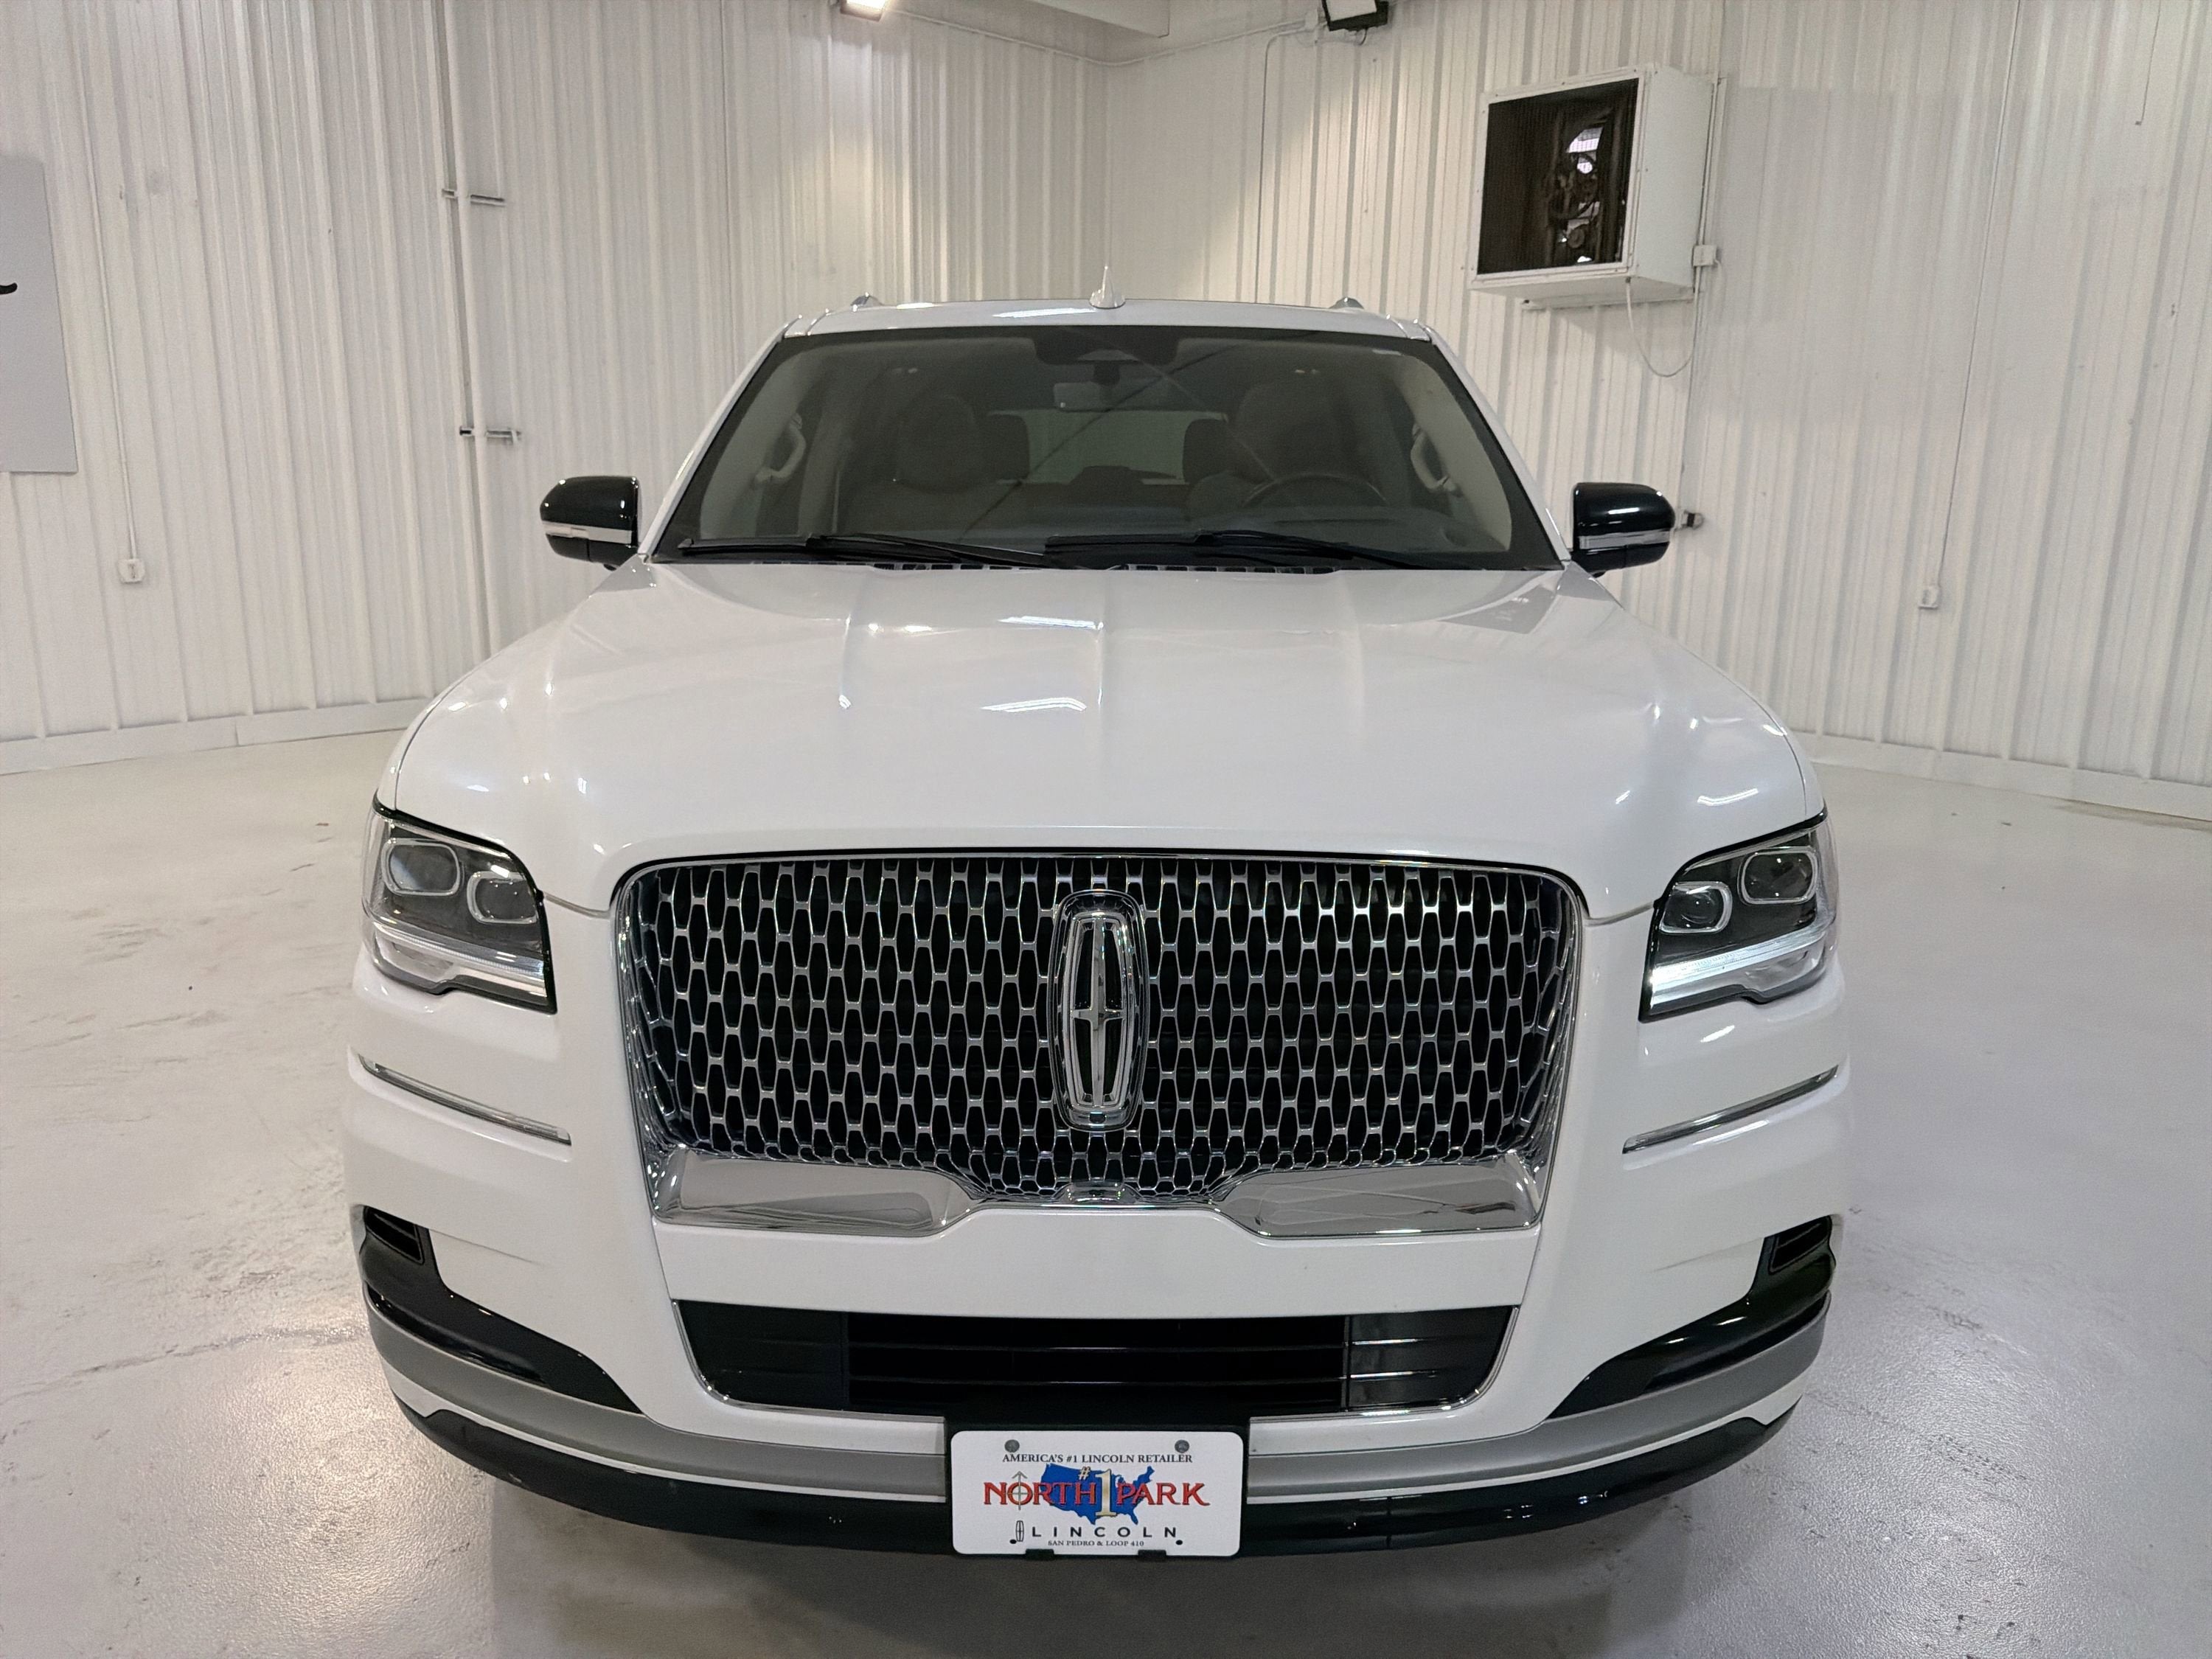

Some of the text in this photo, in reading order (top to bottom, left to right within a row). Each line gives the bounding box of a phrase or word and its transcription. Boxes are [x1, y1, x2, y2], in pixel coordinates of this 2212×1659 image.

[1003, 1453, 1193, 1464] AMERICA'S #1 LINCOLN RETAILER
[983, 1482, 1211, 1506] NORTH PARK
[1032, 1526, 1177, 1538] LINCOLN
